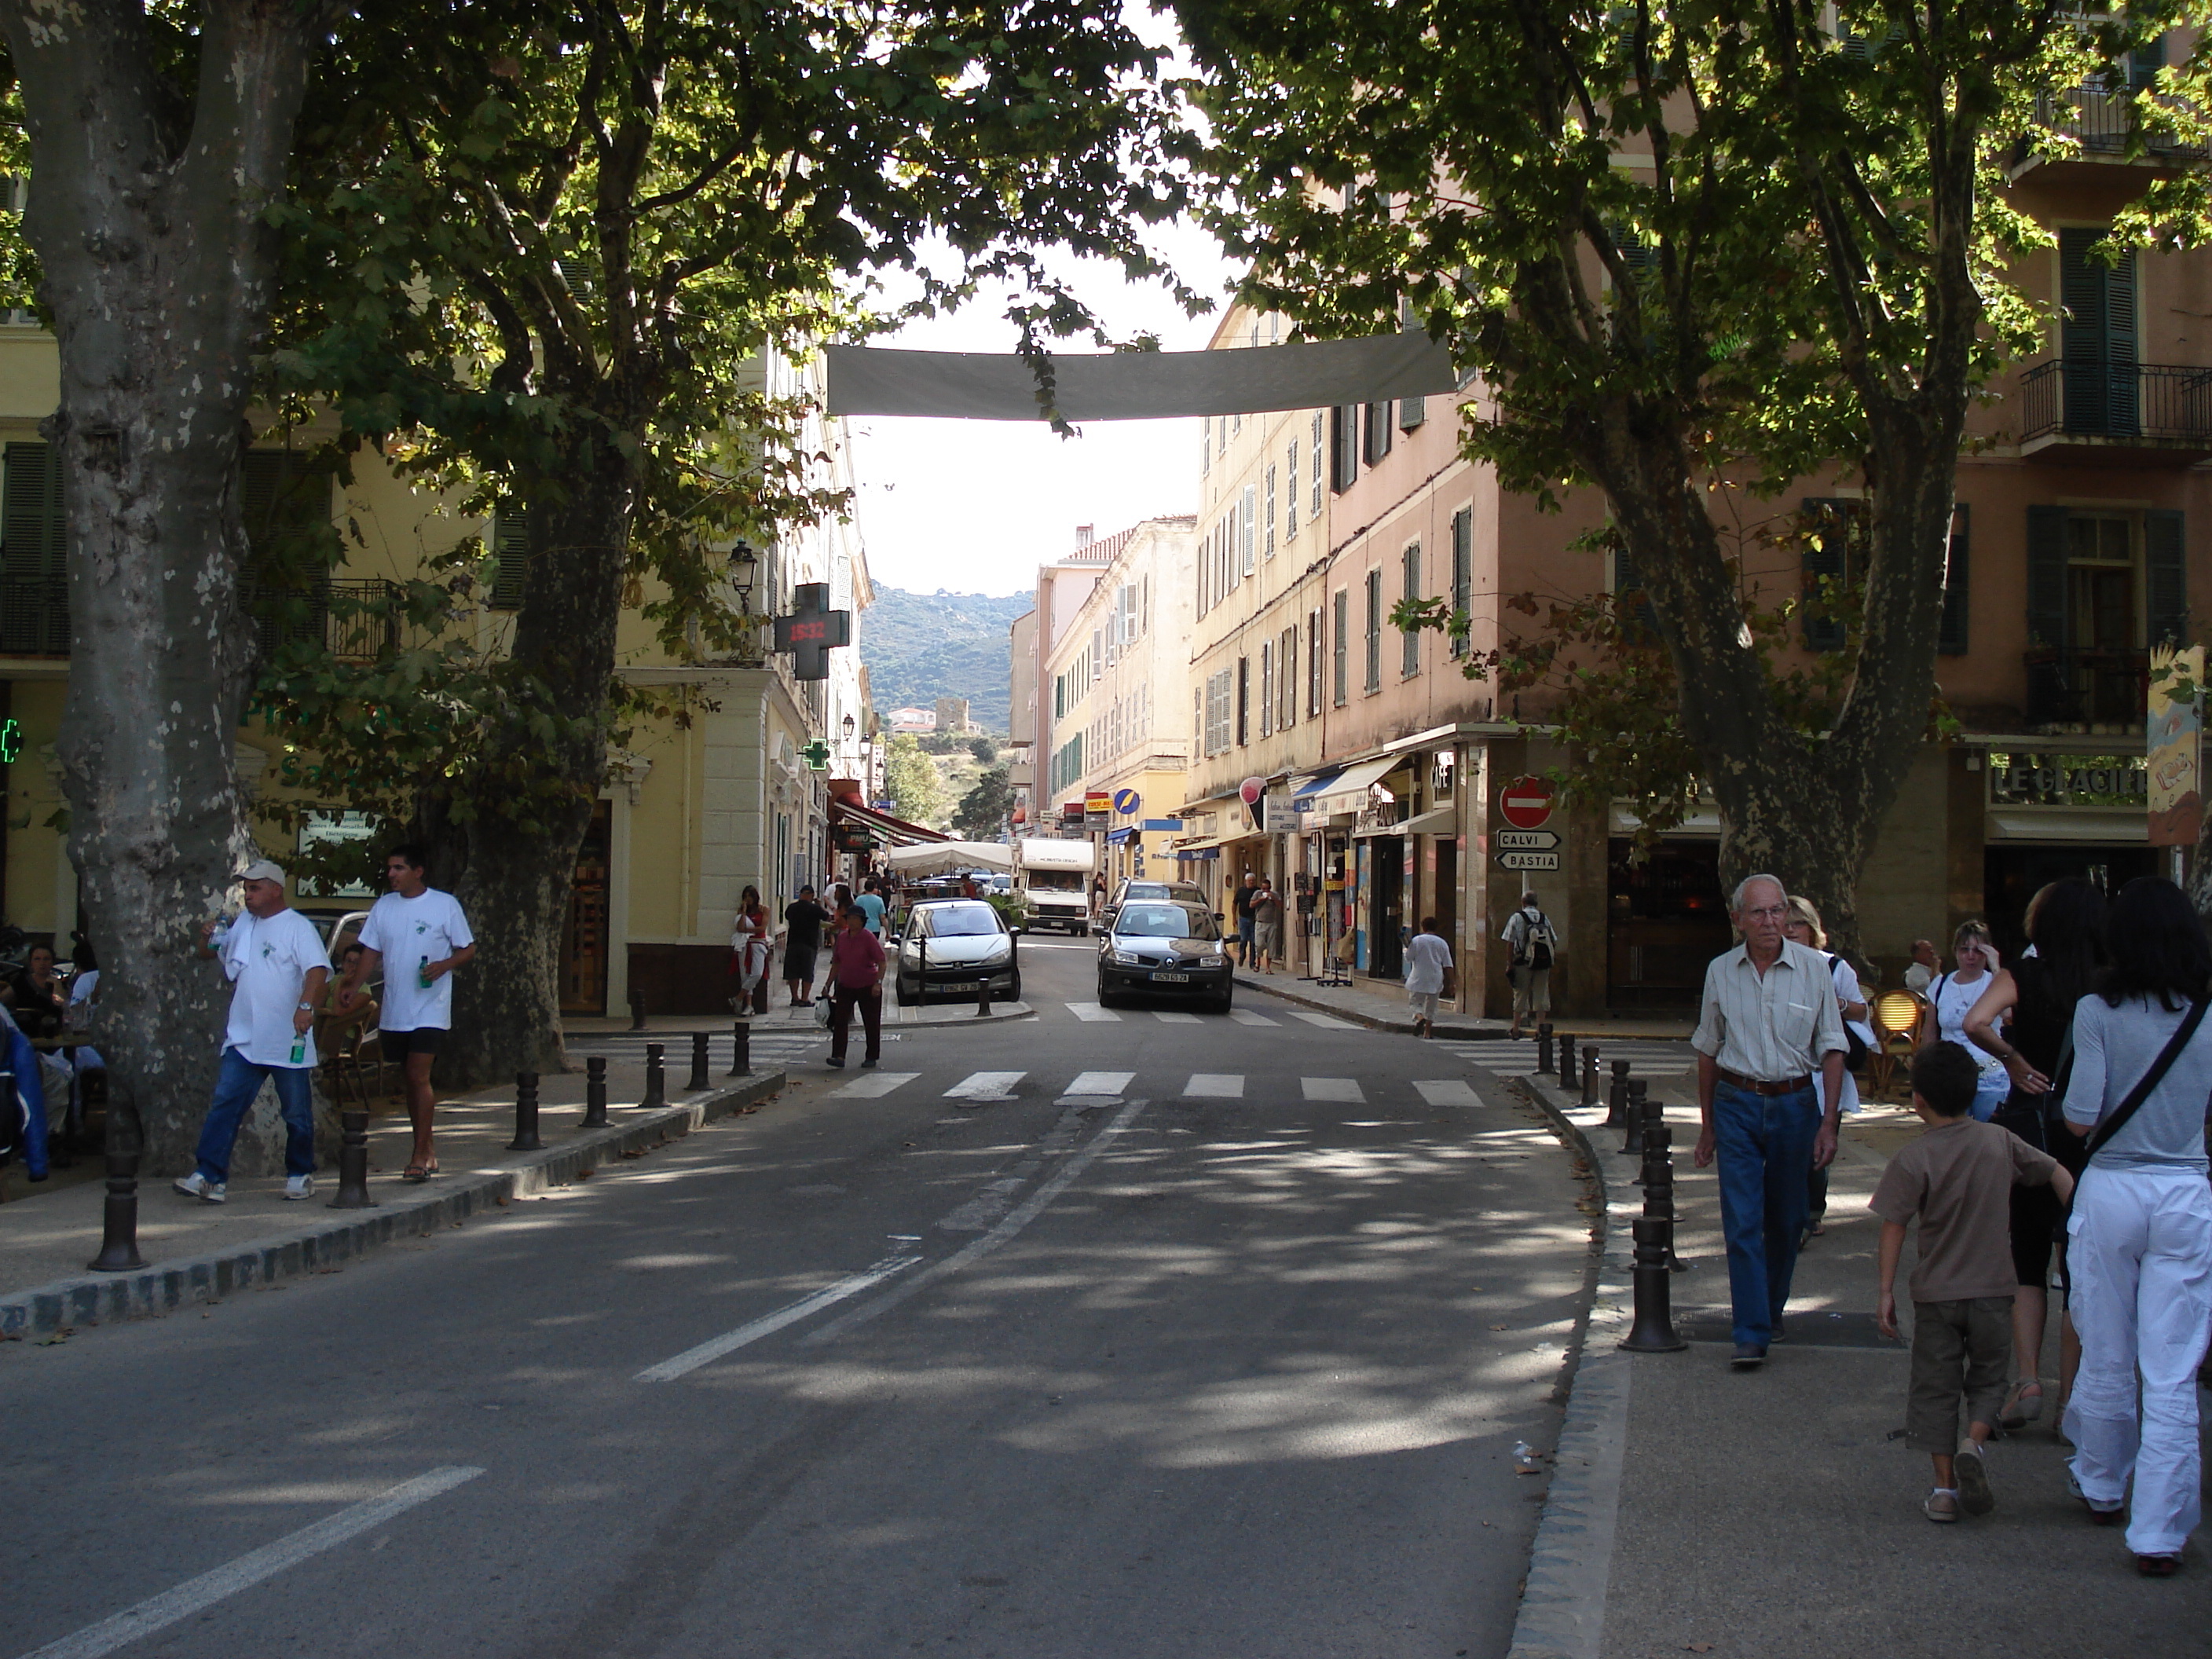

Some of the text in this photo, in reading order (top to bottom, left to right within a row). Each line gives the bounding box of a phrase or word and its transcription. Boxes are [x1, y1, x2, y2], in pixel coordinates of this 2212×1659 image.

[790, 621, 825, 641] 15:32
[1994, 767, 2028, 792] LE
[1502, 836, 1538, 845] CALVI
[1511, 856, 1555, 866] BASTIA
